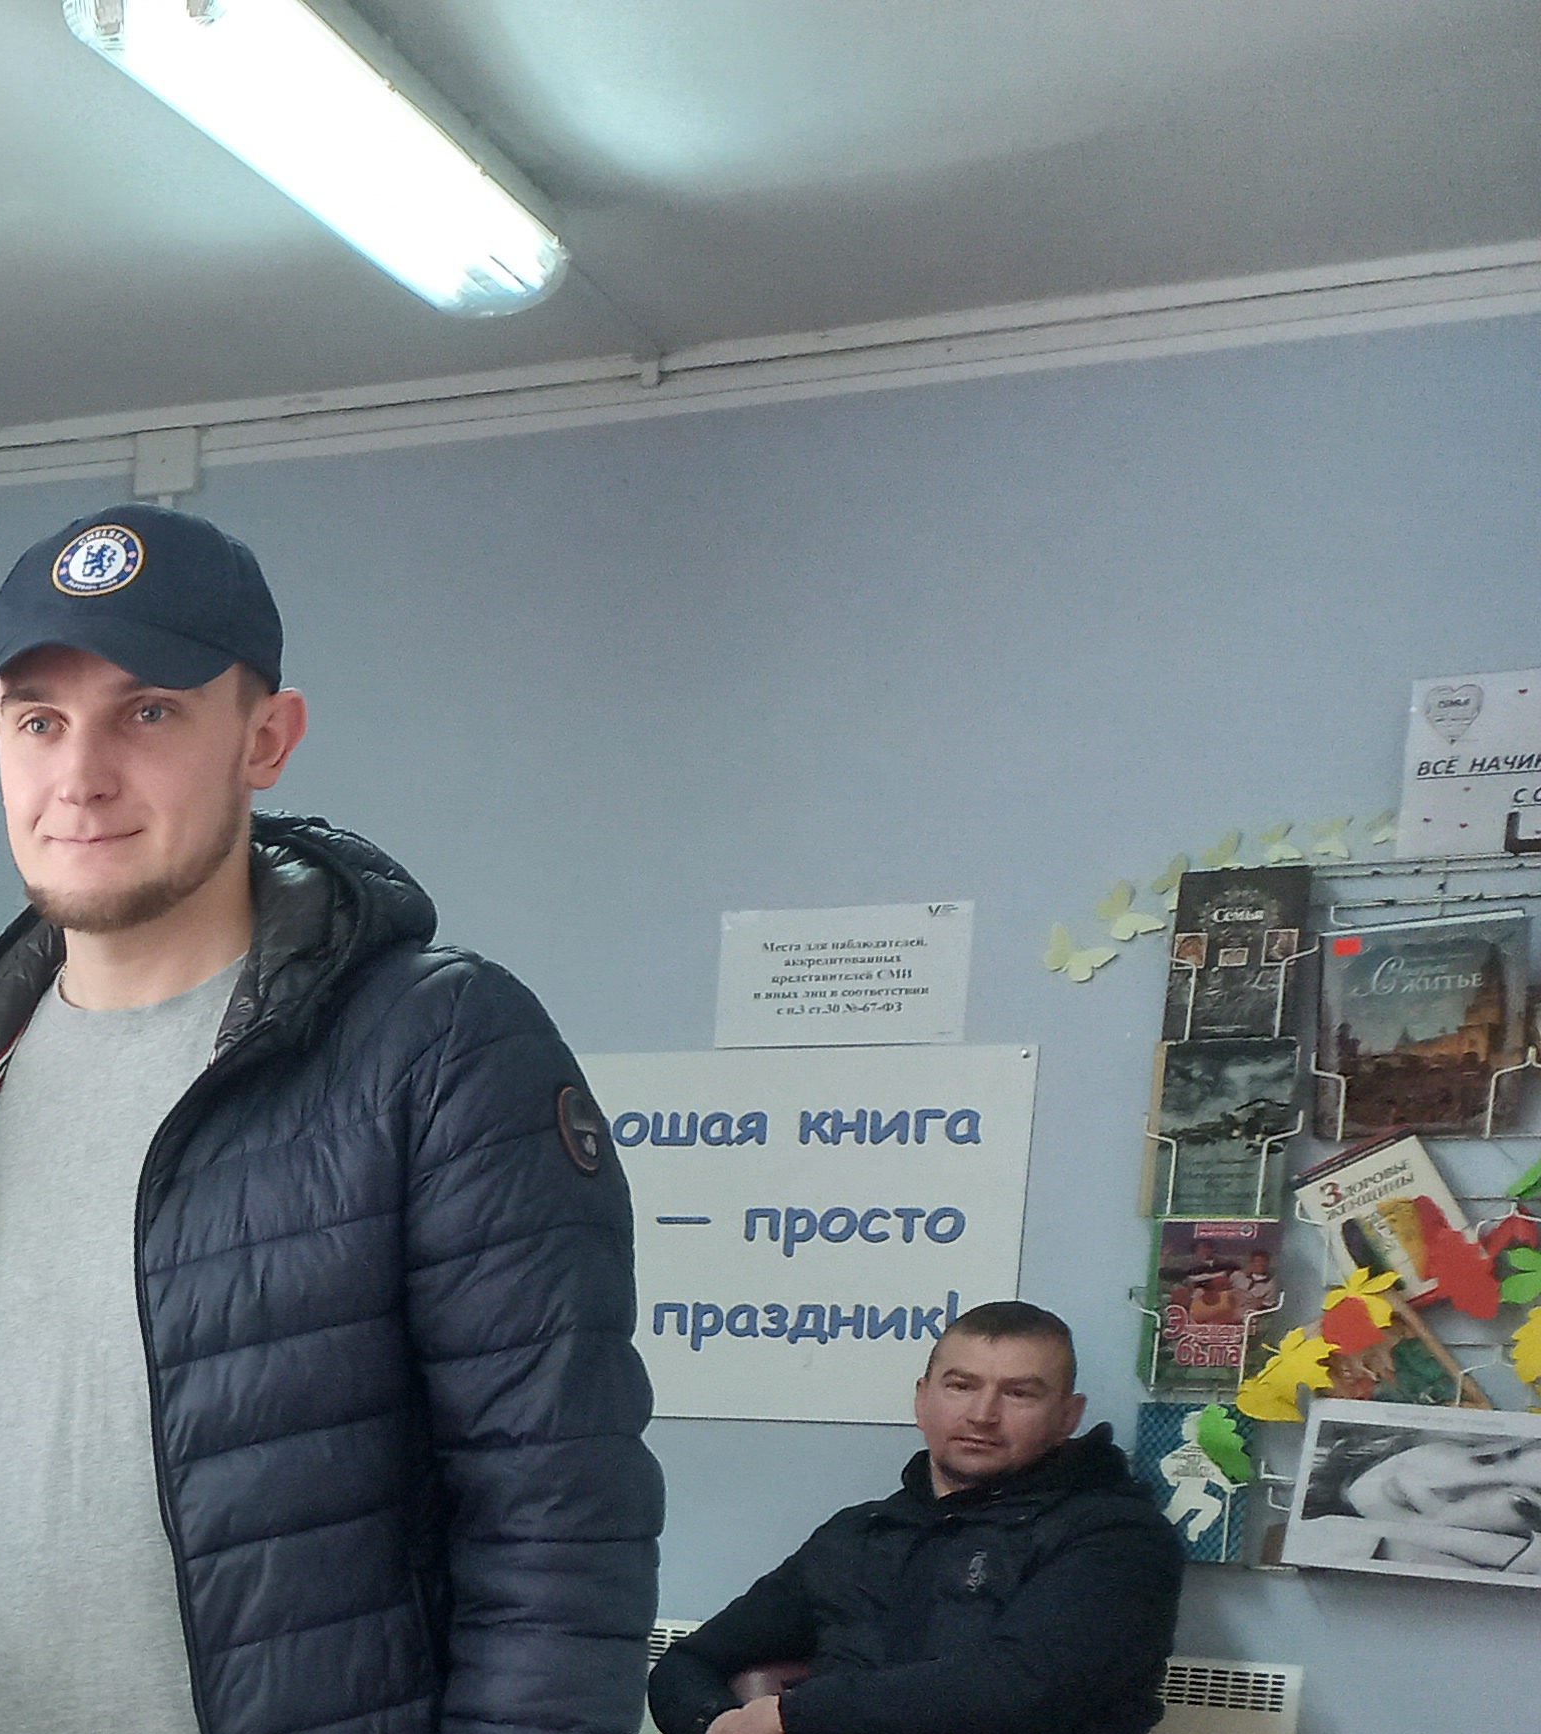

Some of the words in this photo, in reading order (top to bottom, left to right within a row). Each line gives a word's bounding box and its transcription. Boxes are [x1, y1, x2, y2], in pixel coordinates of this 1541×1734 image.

[79, 529, 129, 547] CHELSEA
[1417, 756, 1460, 777] ВСЁ
[877, 968, 913, 980] СМИ
[609, 1110, 768, 1147] ошая
[798, 1108, 982, 1146] книга
[744, 1206, 967, 1258] просто
